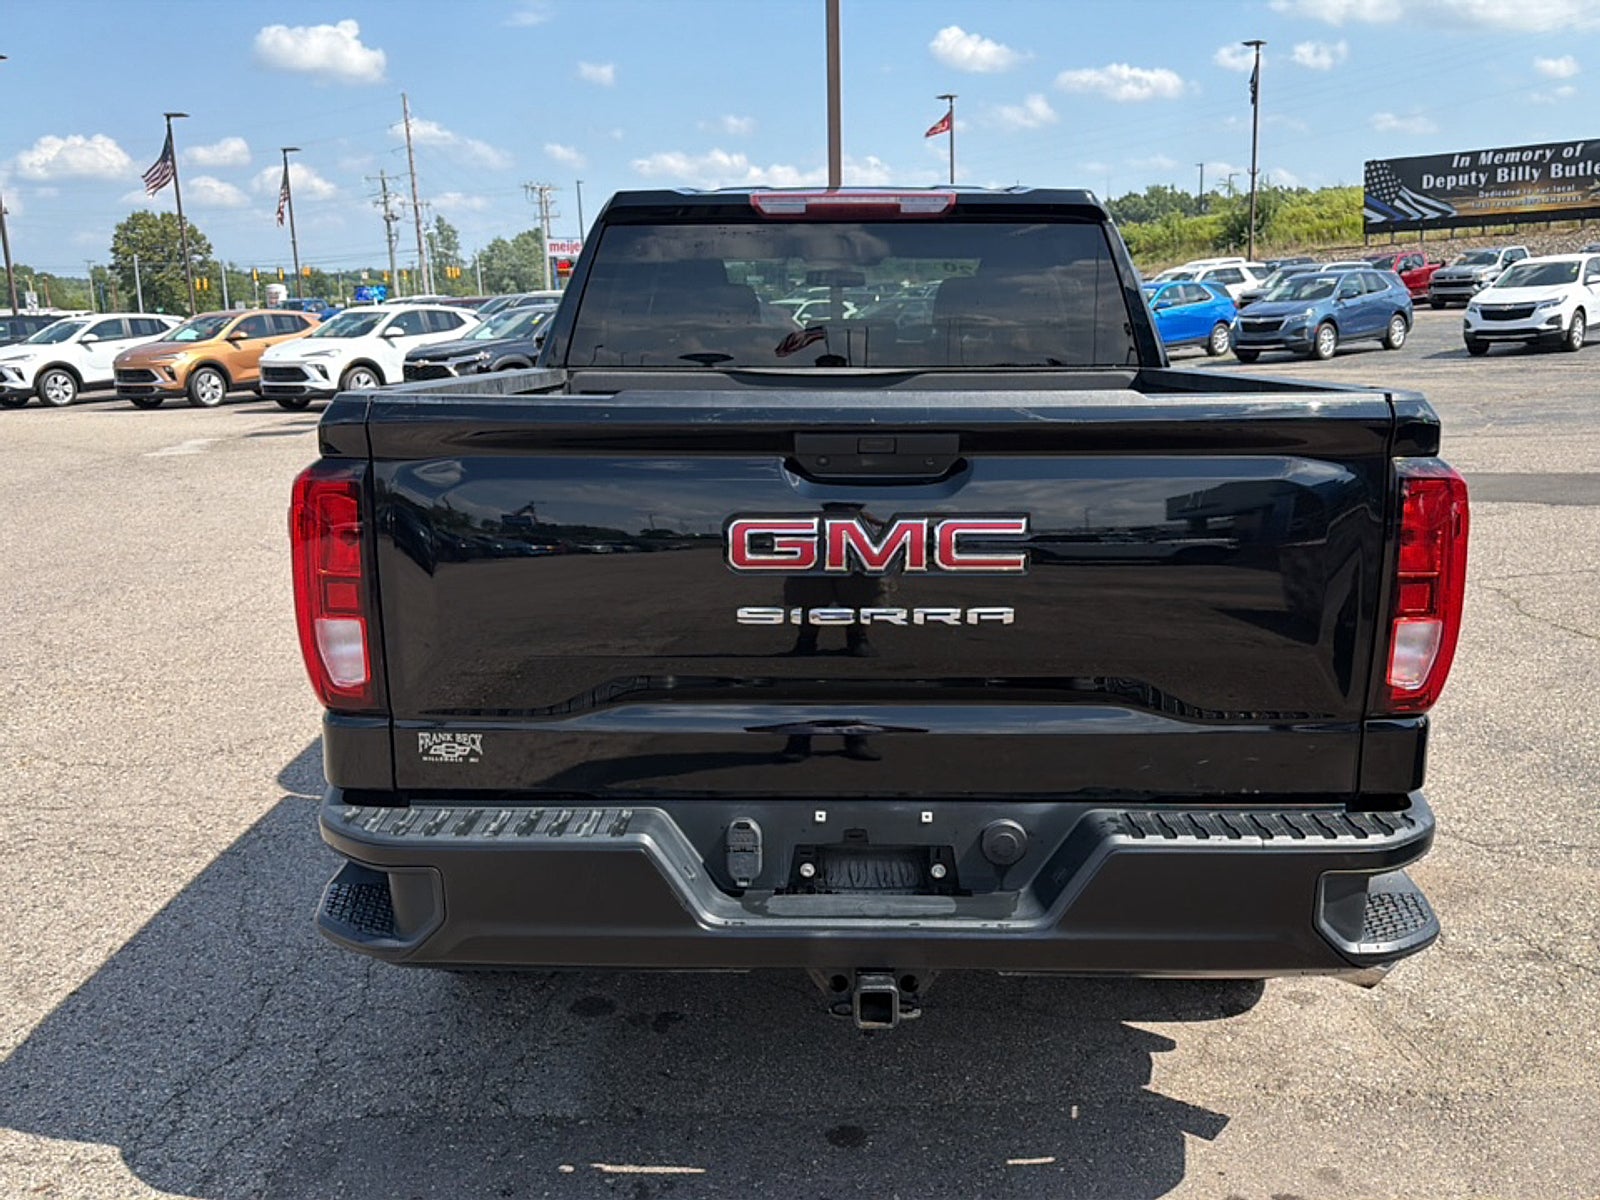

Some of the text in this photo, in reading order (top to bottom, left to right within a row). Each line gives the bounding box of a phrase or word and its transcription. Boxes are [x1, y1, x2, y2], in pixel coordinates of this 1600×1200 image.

[1452, 142, 1585, 168] In Memory of
[1422, 171, 1489, 191] Deputy
[1496, 165, 1542, 184] Billy
[549, 240, 583, 254] meije
[728, 516, 1027, 572] GMC
[736, 606, 1015, 626] SIERRA
[418, 732, 483, 756] FRANK BECK
